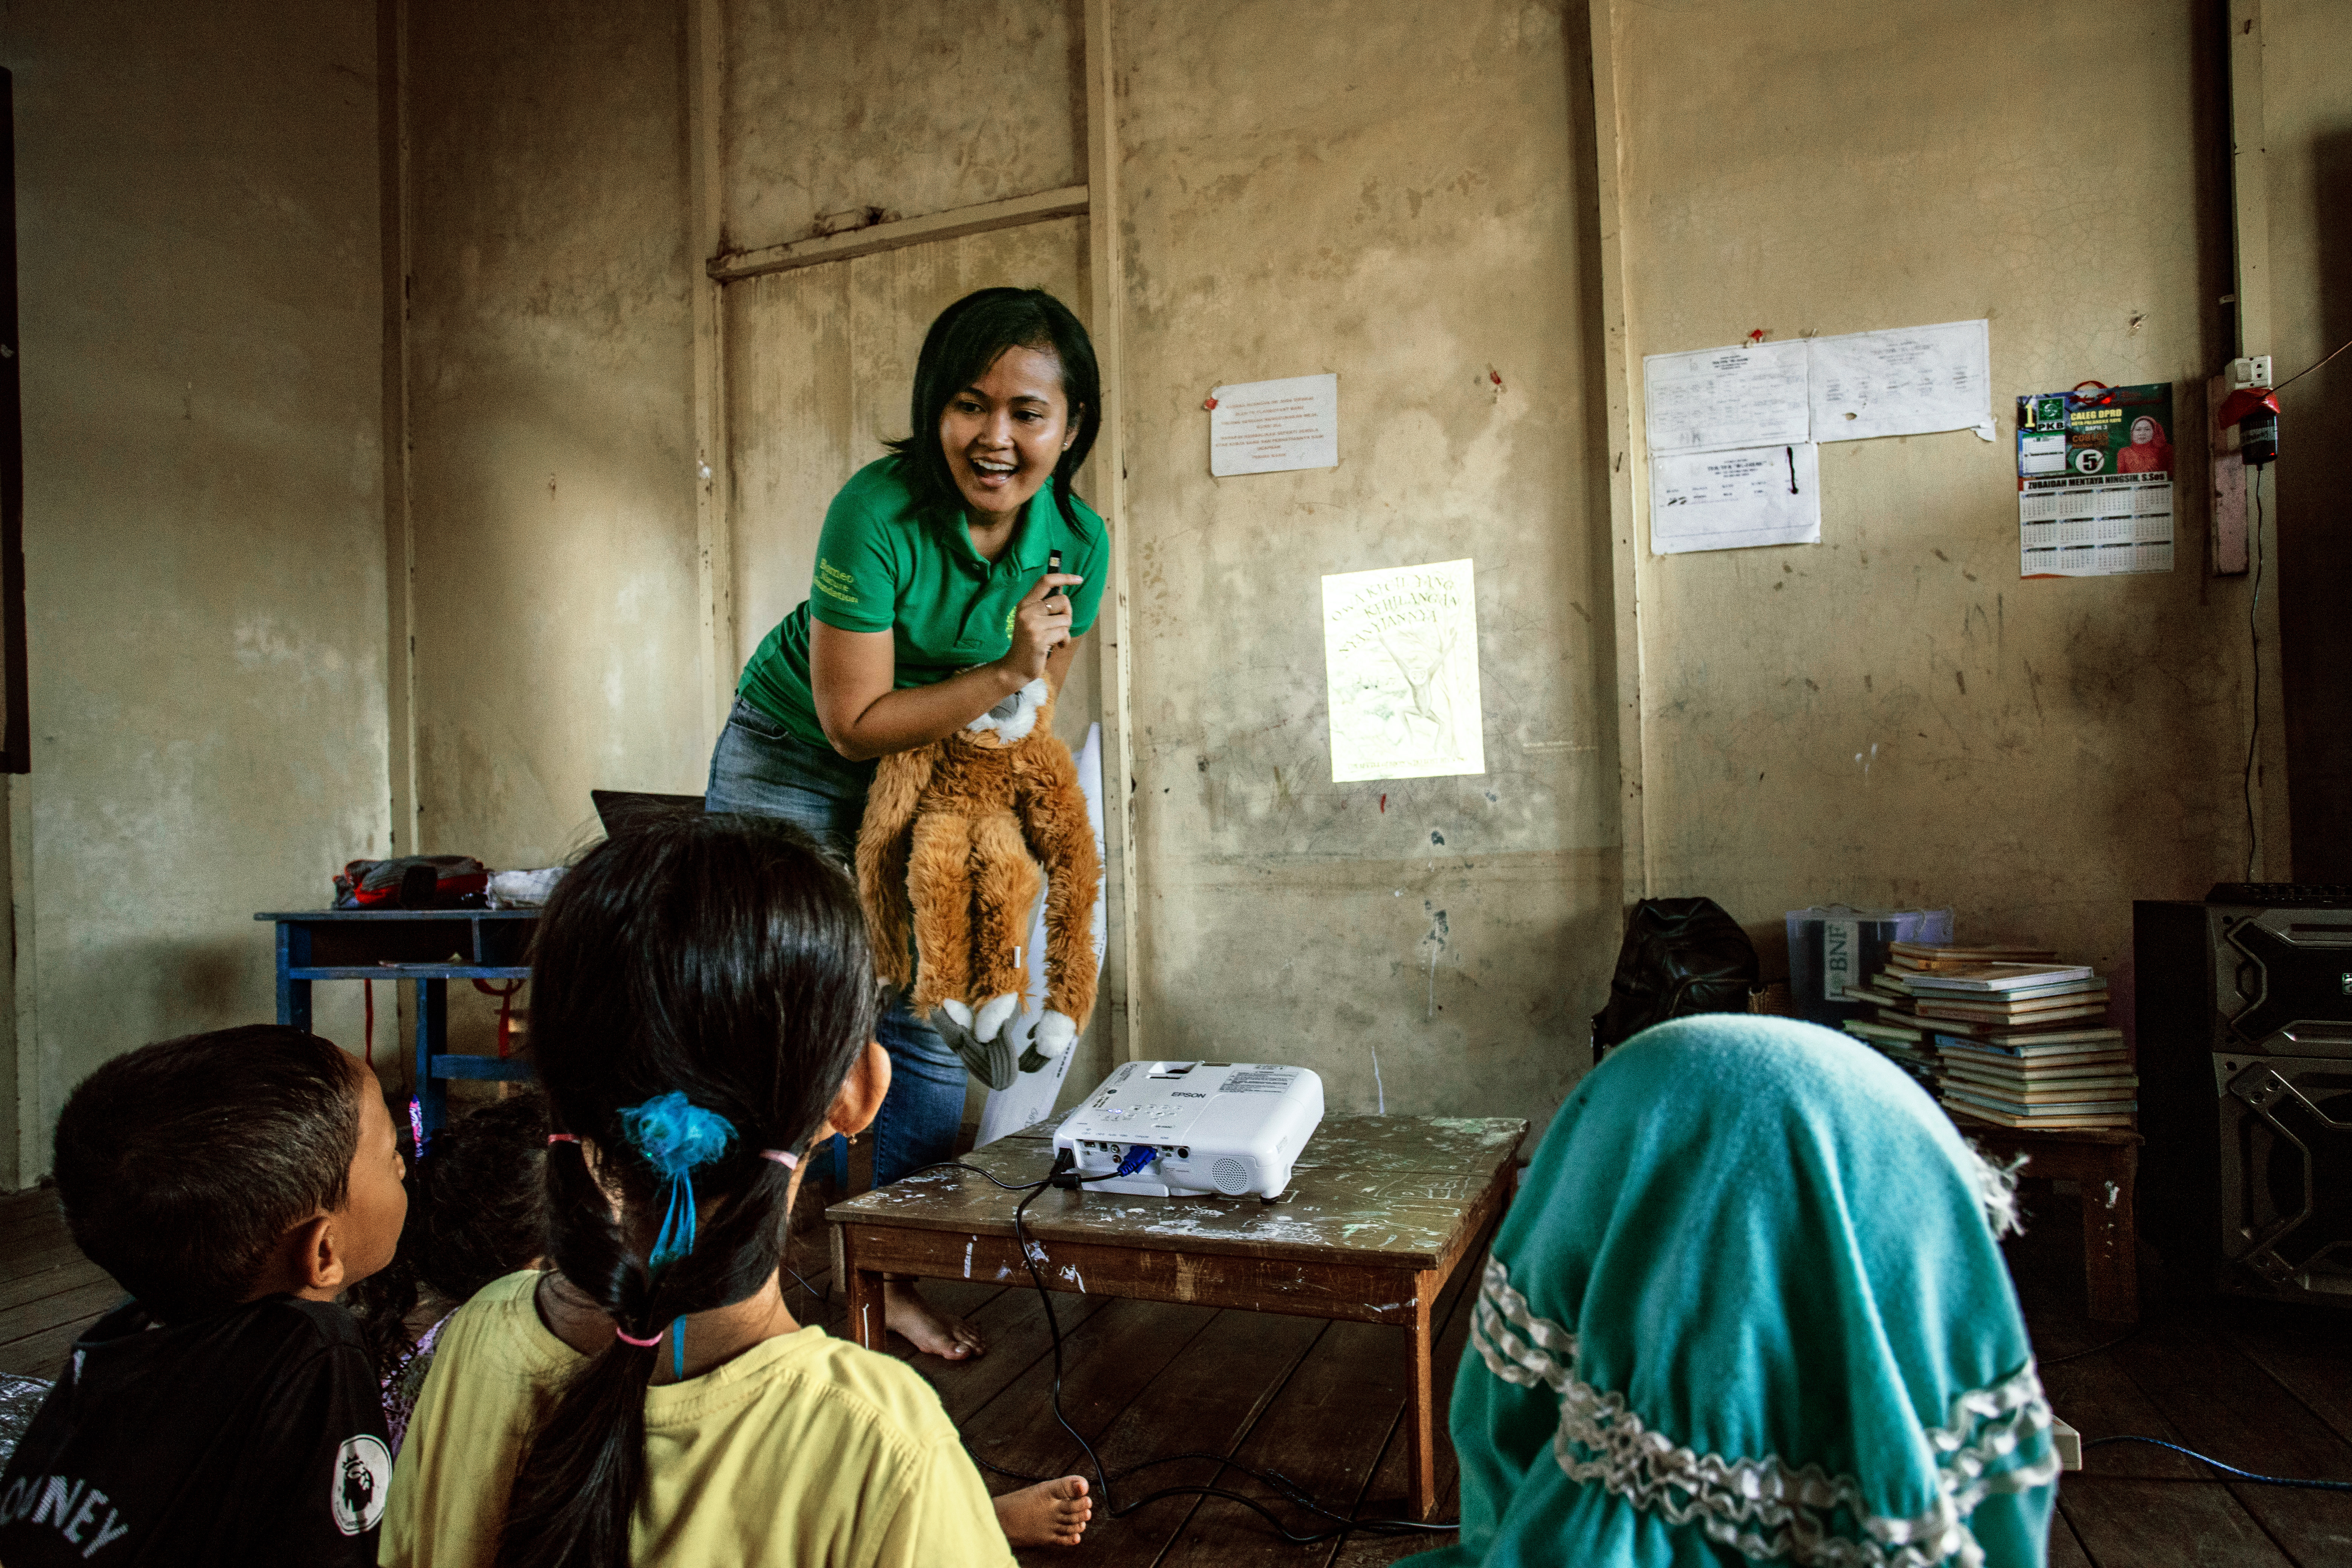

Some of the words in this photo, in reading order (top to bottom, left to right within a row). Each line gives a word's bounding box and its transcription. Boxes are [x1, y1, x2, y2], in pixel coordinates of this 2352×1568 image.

[2025, 404, 2035, 428] 1
[2070, 410, 2096, 421] CALEG
[2098, 408, 2122, 418] DPRD
[2082, 454, 2098, 471] 5
[2069, 477, 2104, 487] MENTAYA
[1828, 923, 1848, 973] BNF
